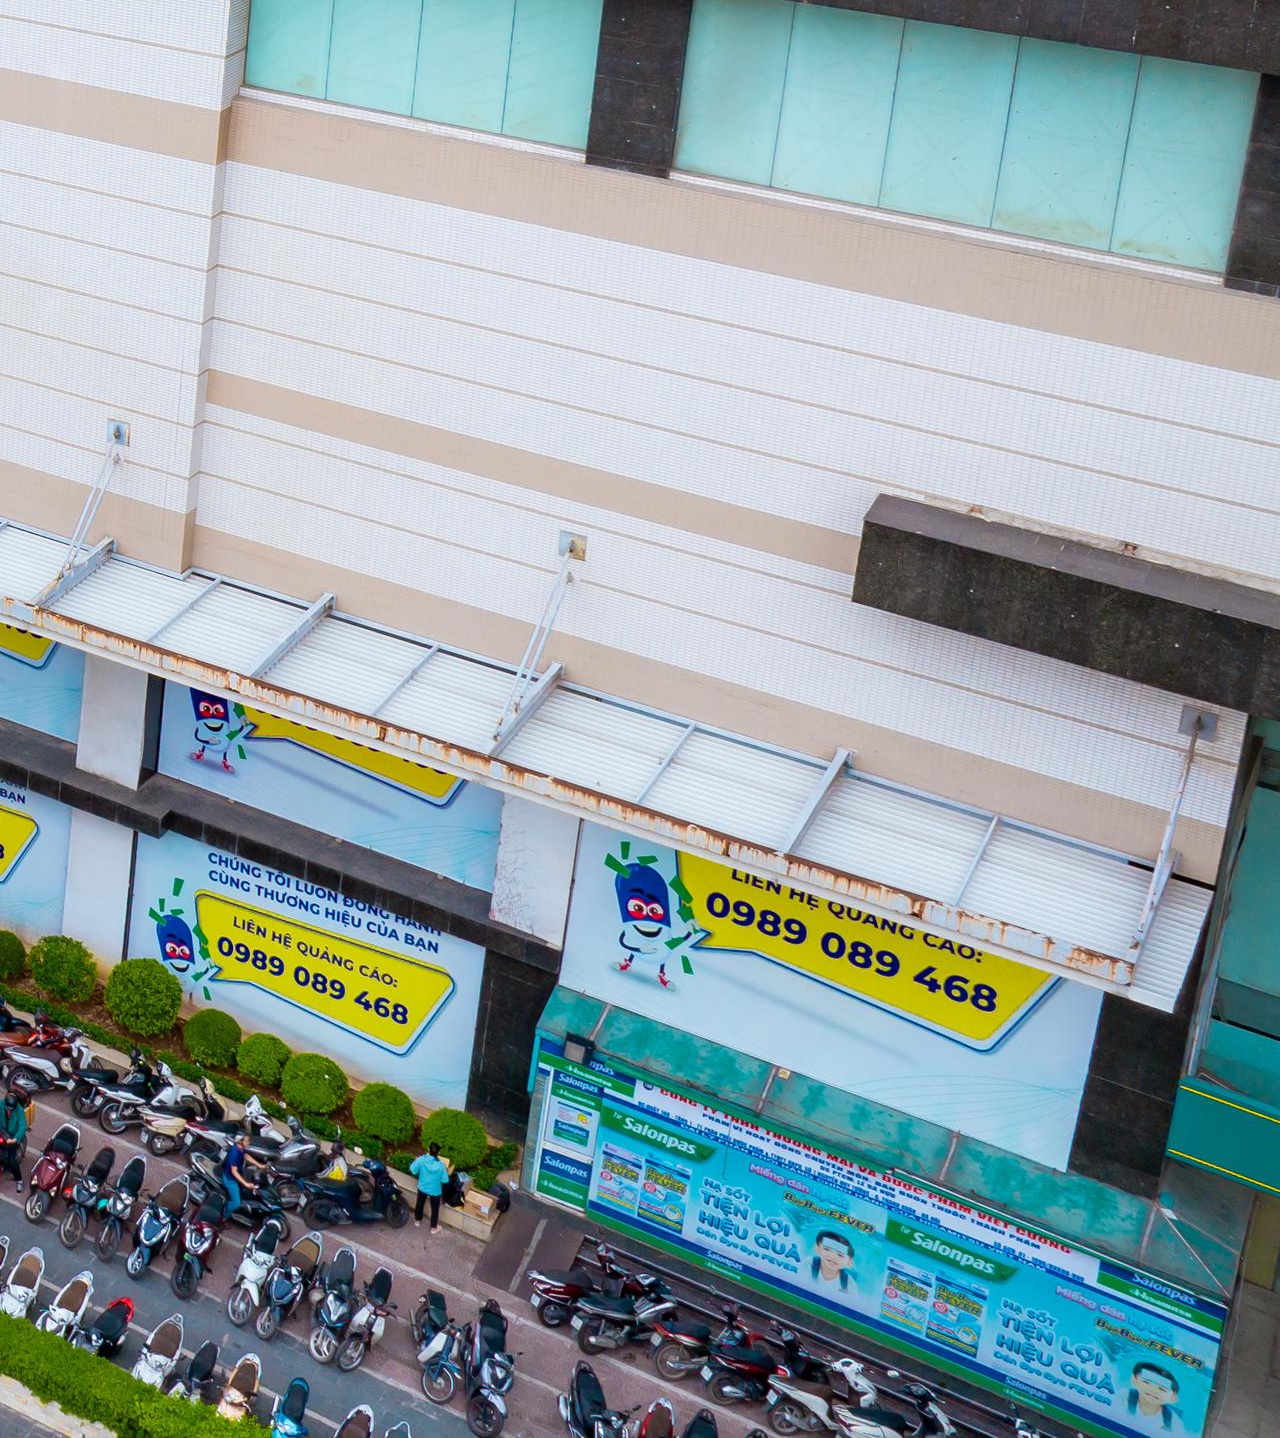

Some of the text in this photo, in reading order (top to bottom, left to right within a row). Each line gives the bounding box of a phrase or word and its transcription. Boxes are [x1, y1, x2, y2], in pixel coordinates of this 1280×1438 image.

[0, 788, 25, 804] BẠN
[208, 852, 262, 878] CHÚNG
[265, 870, 291, 888] TÔI
[208, 870, 439, 954] CÙNG THƯƠNG HIỆU CỦA BẠN
[233, 916, 398, 988] LIÊN HỆ QUẢNG CÁO:
[706, 892, 998, 1012] 0989 089 468
[217, 936, 409, 1025] 0989 089 468
[558, 1073, 600, 1093] Salonpas
[623, 1117, 697, 1155] Salonpas
[544, 1155, 588, 1177] Salonpas
[704, 1178, 722, 1194] HẠ
[725, 1182, 751, 1202] SỐT
[699, 1211, 748, 1240] HIỆU
[700, 1190, 790, 1237] TIỆN LỢI
[912, 1231, 996, 1275] Salonpas
[1132, 1274, 1197, 1305] Salonpas
[1002, 1299, 1023, 1315] HẠ
[1026, 1308, 1057, 1327] SỐT
[996, 1333, 1054, 1367] HIỆU
[999, 1312, 1103, 1366] TIỆN LỢI
